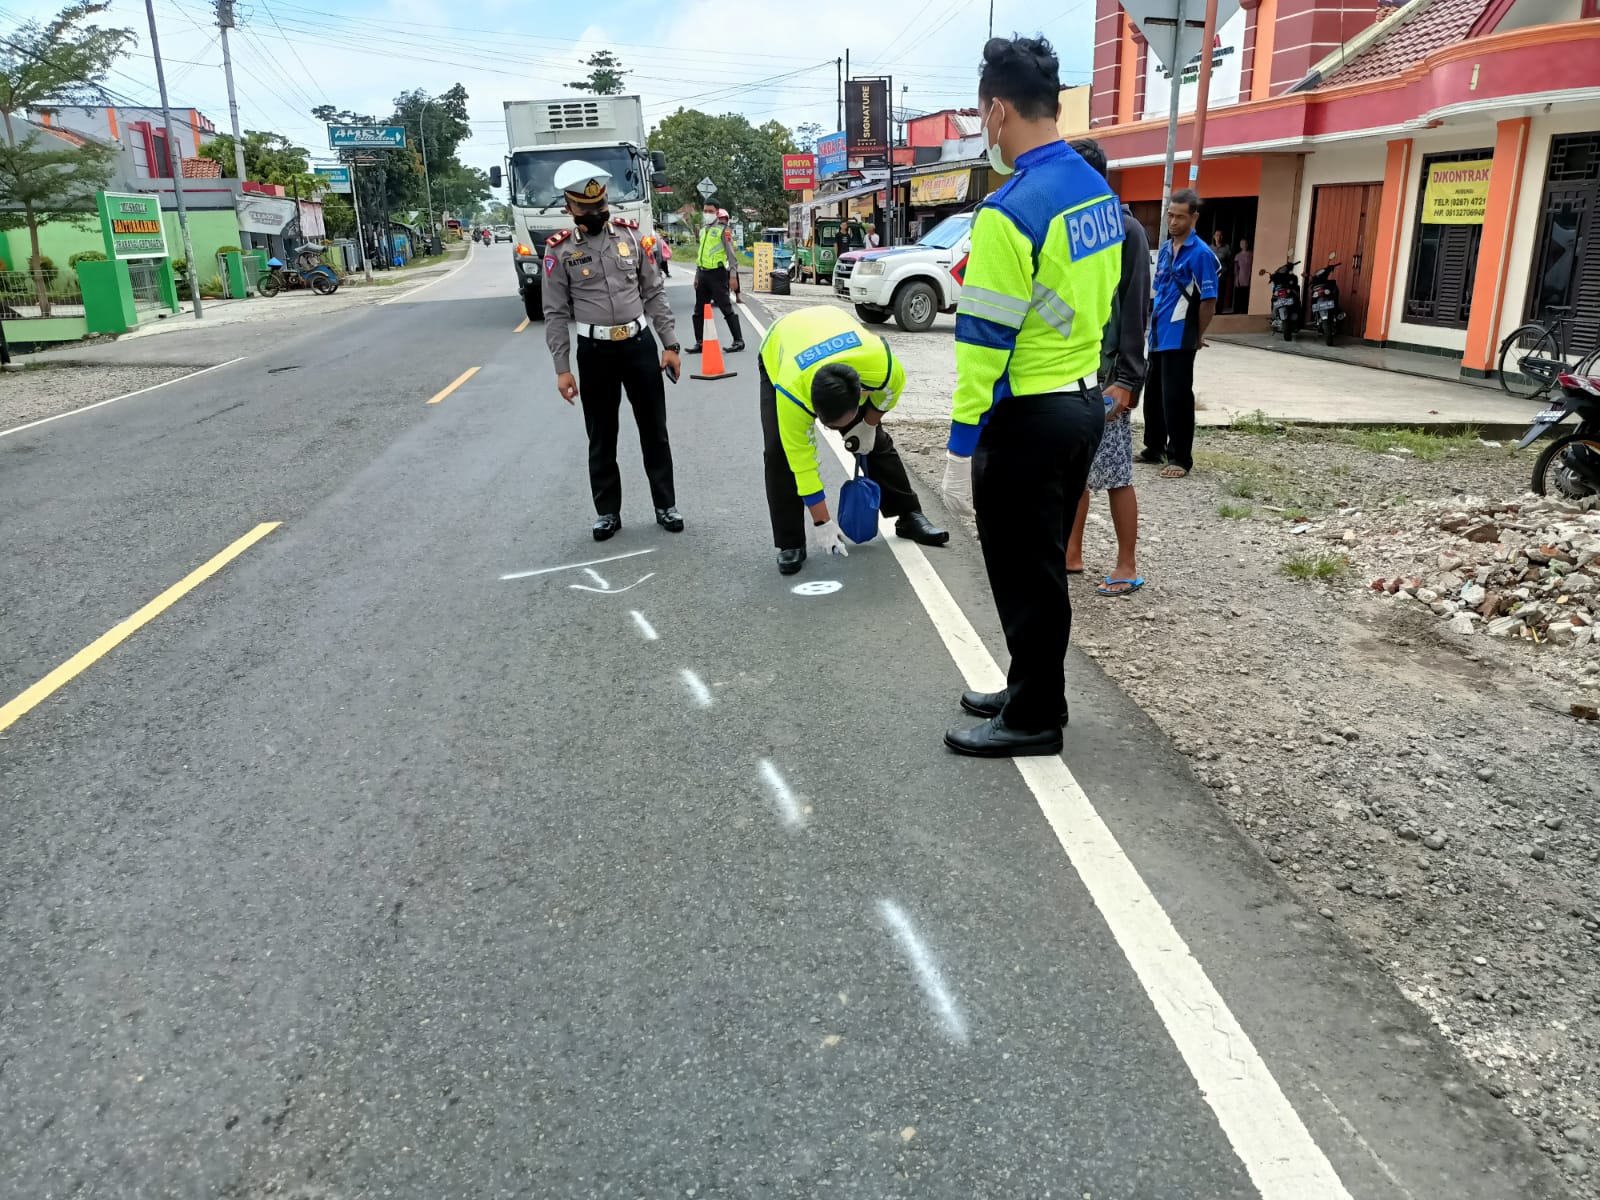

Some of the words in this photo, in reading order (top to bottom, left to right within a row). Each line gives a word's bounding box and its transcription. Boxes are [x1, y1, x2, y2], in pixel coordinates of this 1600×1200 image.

[862, 85, 871, 138] SIGNATURE
[787, 159, 811, 168] GRIYA
[1433, 169, 1490, 184] DIKONTRAK
[1069, 201, 1123, 256] POLISI
[798, 333, 857, 365] POLISI
